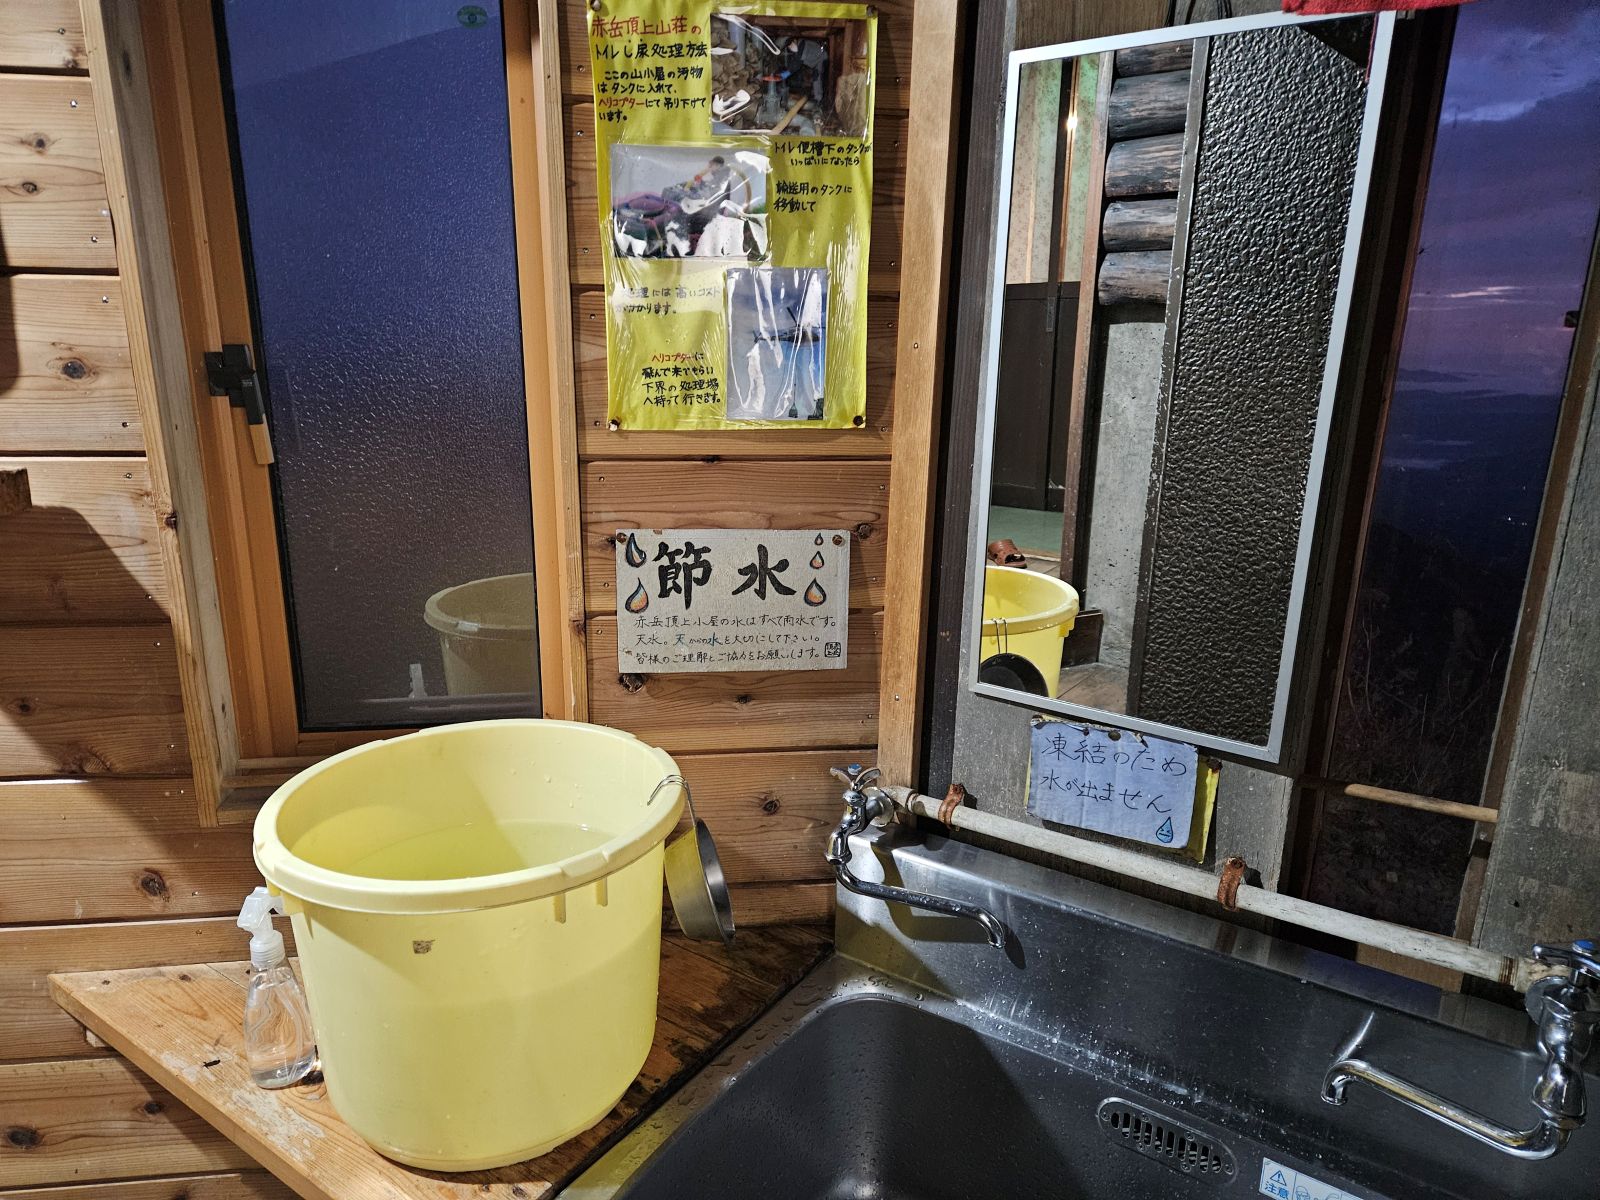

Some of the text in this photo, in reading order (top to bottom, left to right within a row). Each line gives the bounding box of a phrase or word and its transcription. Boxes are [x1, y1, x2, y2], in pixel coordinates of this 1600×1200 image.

[592, 15, 702, 38] 赤岳頂上山荘の
[596, 41, 707, 60] トイレし尿処理方法
[599, 109, 628, 123] います。
[776, 180, 853, 196] 輸送用のタンクに
[773, 197, 816, 213] 移動して
[642, 378, 719, 394] 下界の処理場
[652, 541, 797, 610] 節水
[634, 614, 837, 629] 赤岳頂上小屋の水はすべて雨水です。
[1041, 732, 1187, 776] 凍結のため
[1039, 769, 1172, 813] 水が出ません
[1264, 1181, 1290, 1200] 注意
